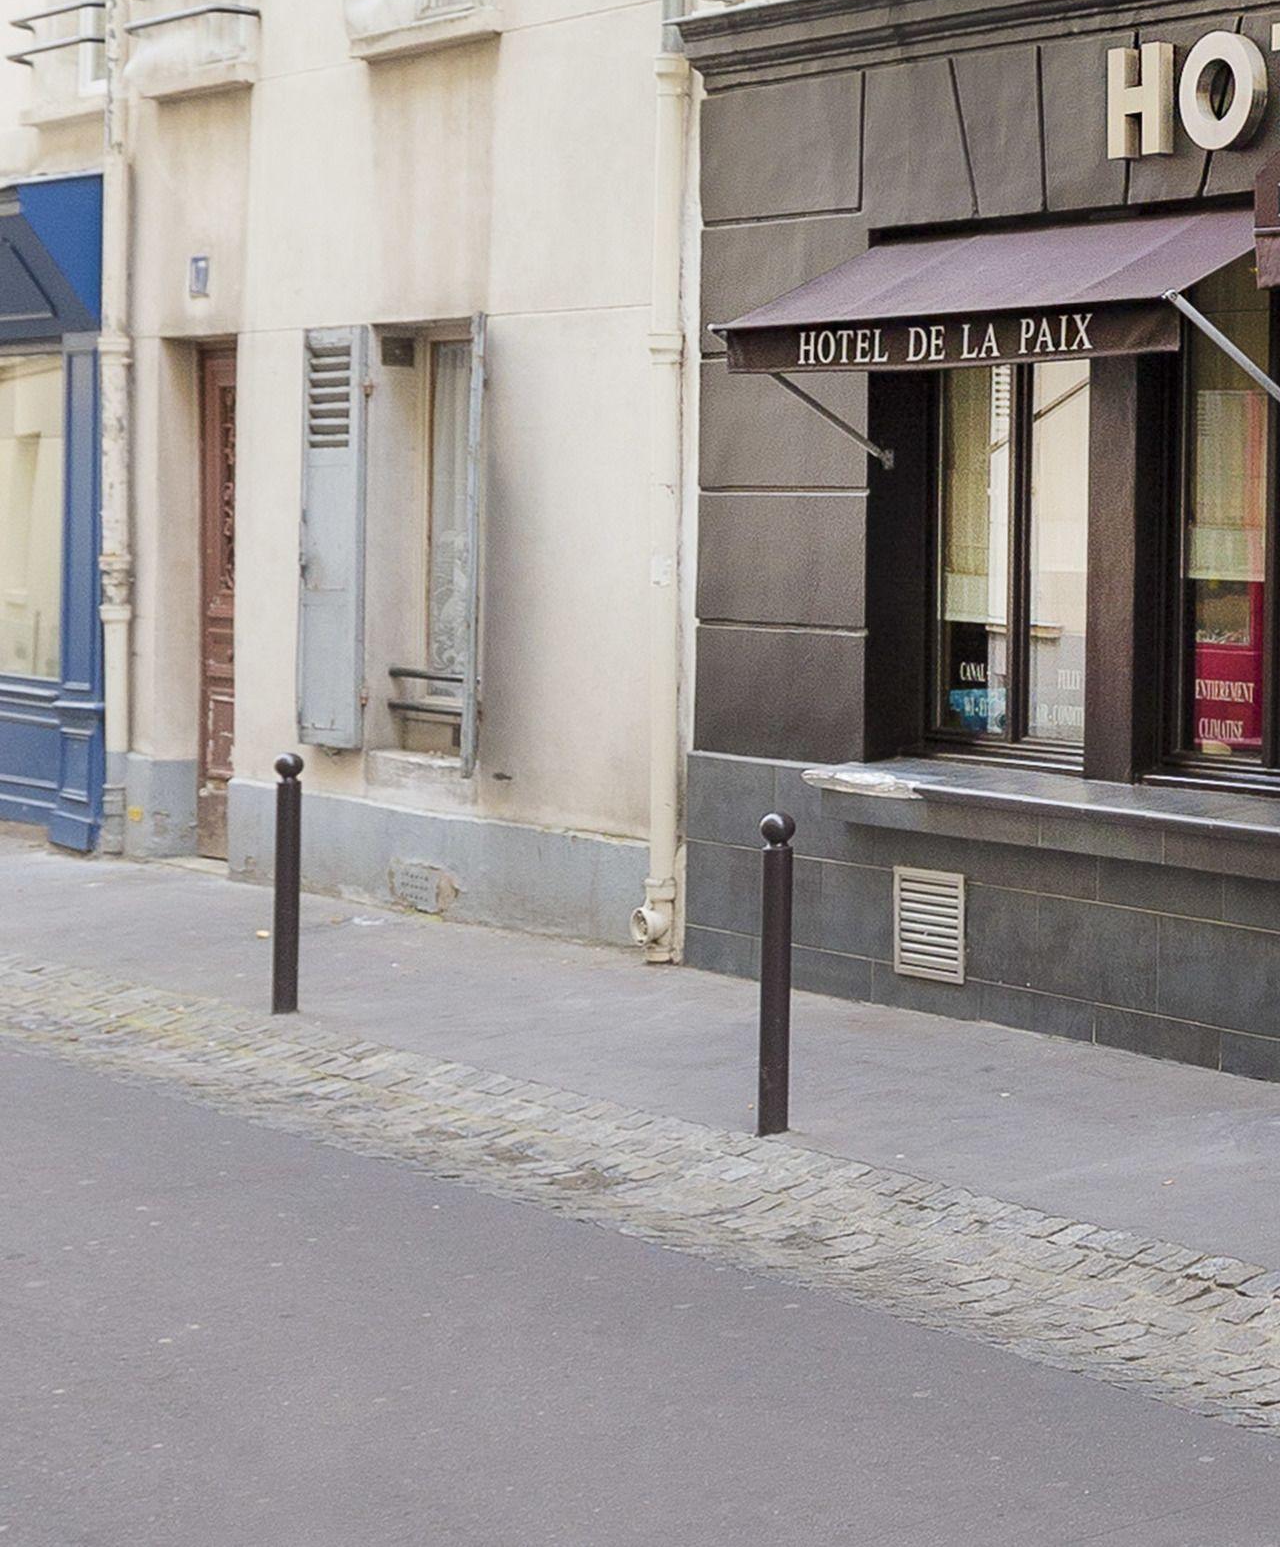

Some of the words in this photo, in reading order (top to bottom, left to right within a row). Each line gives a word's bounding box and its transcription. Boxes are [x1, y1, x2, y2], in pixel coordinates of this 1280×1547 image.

[797, 328, 889, 365] HOTEL
[906, 325, 946, 362] DE
[960, 322, 1001, 360] LA
[1018, 313, 1094, 355] PAIX
[1195, 678, 1254, 703] ENTIEREMENT
[1199, 717, 1243, 741] CLIMATISE
